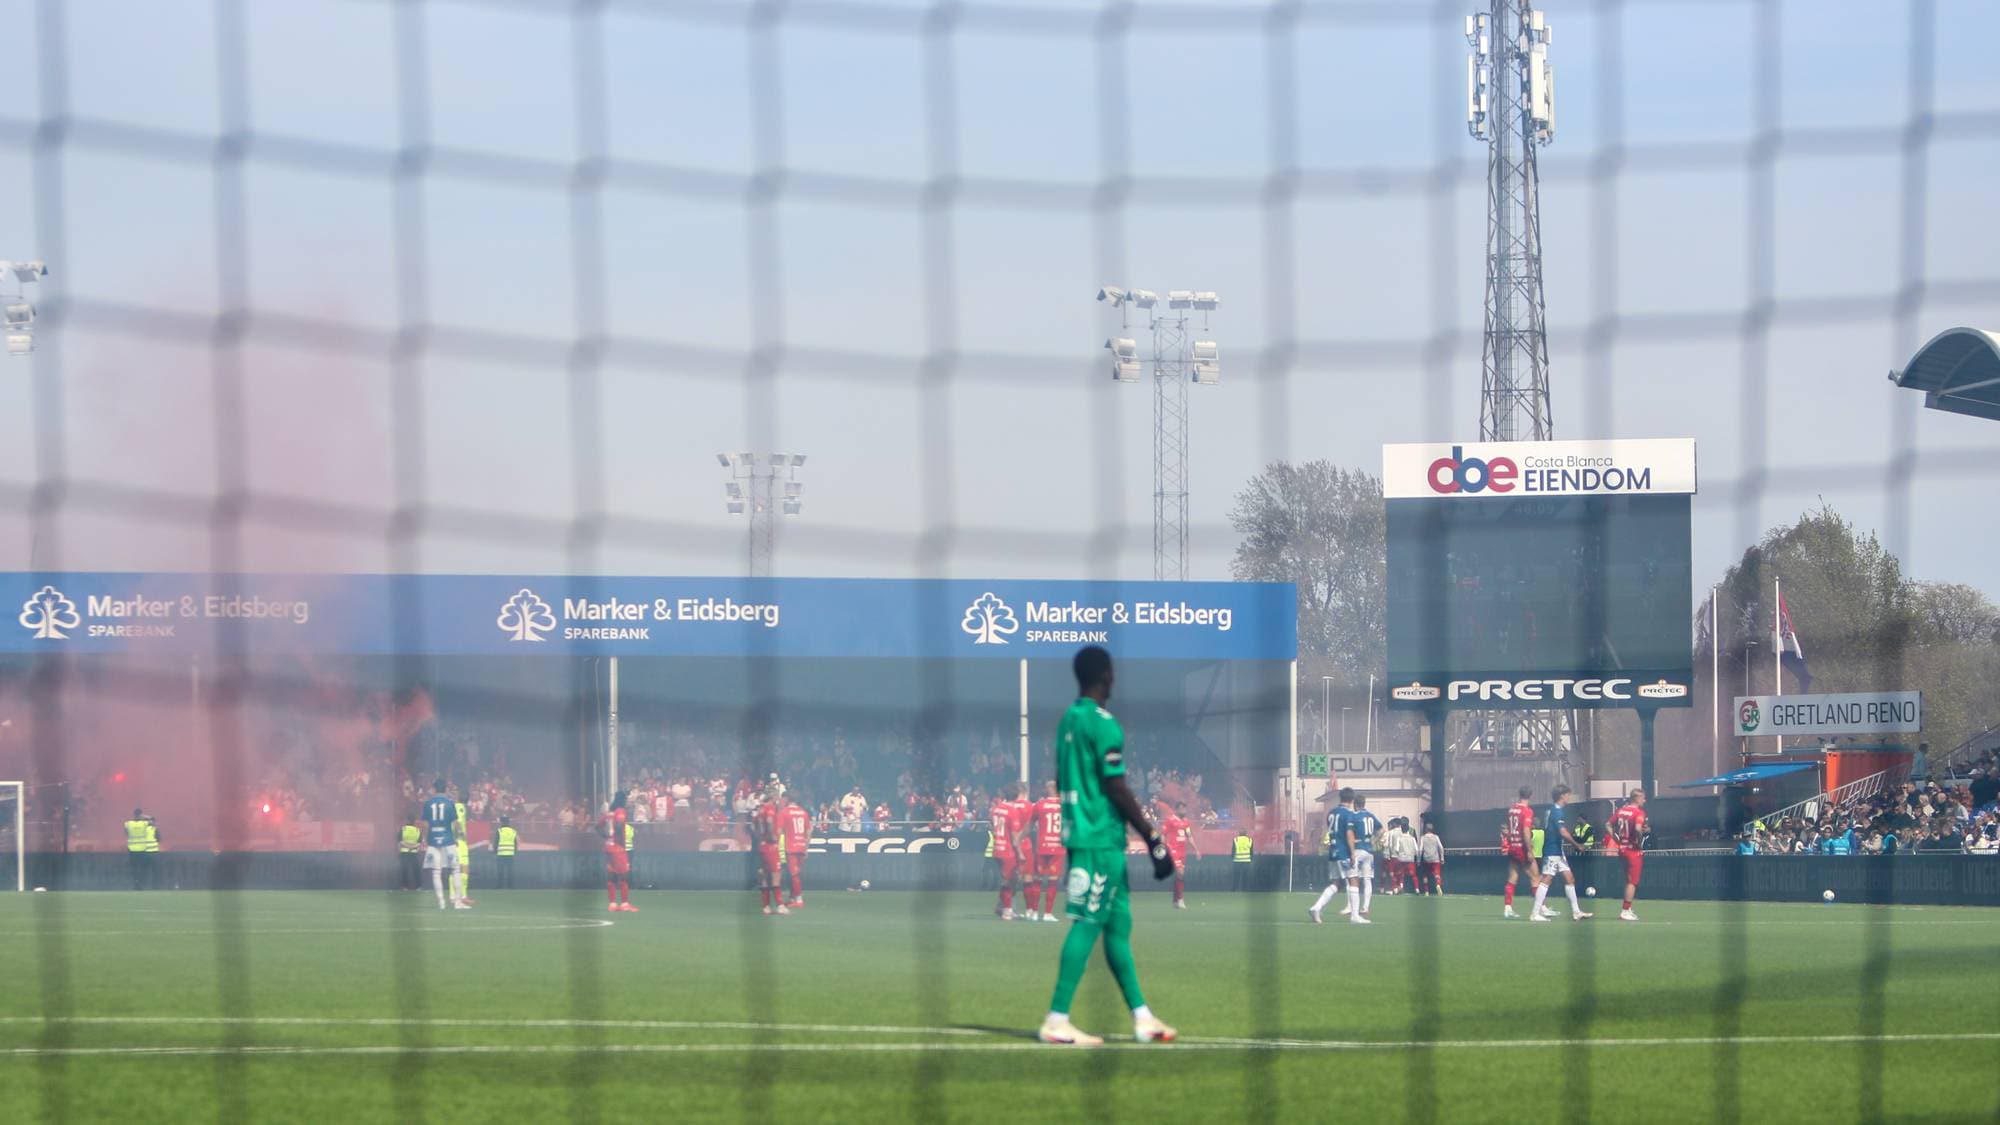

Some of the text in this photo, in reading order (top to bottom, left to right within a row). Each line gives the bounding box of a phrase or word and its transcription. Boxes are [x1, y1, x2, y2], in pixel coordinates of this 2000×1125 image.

[1525, 455, 1613, 468] Costa Blanca
[1524, 467, 1651, 491] EIENDOM
[87, 595, 309, 623] Marker & Eidsberg
[563, 598, 779, 627] Marker & Eidsberg
[1026, 601, 1232, 630] Marker & Eidsberg
[88, 625, 175, 637] SPAREBANK
[564, 628, 650, 640] SPAREBANK
[1026, 630, 1108, 642] SPAREBANK
[1447, 679, 1632, 700] PRETEC
[1772, 701, 1915, 726] GRETLAND RENO
[430, 802, 445, 821] 11
[1046, 812, 1062, 834] 13
[1363, 816, 1375, 836] 10
